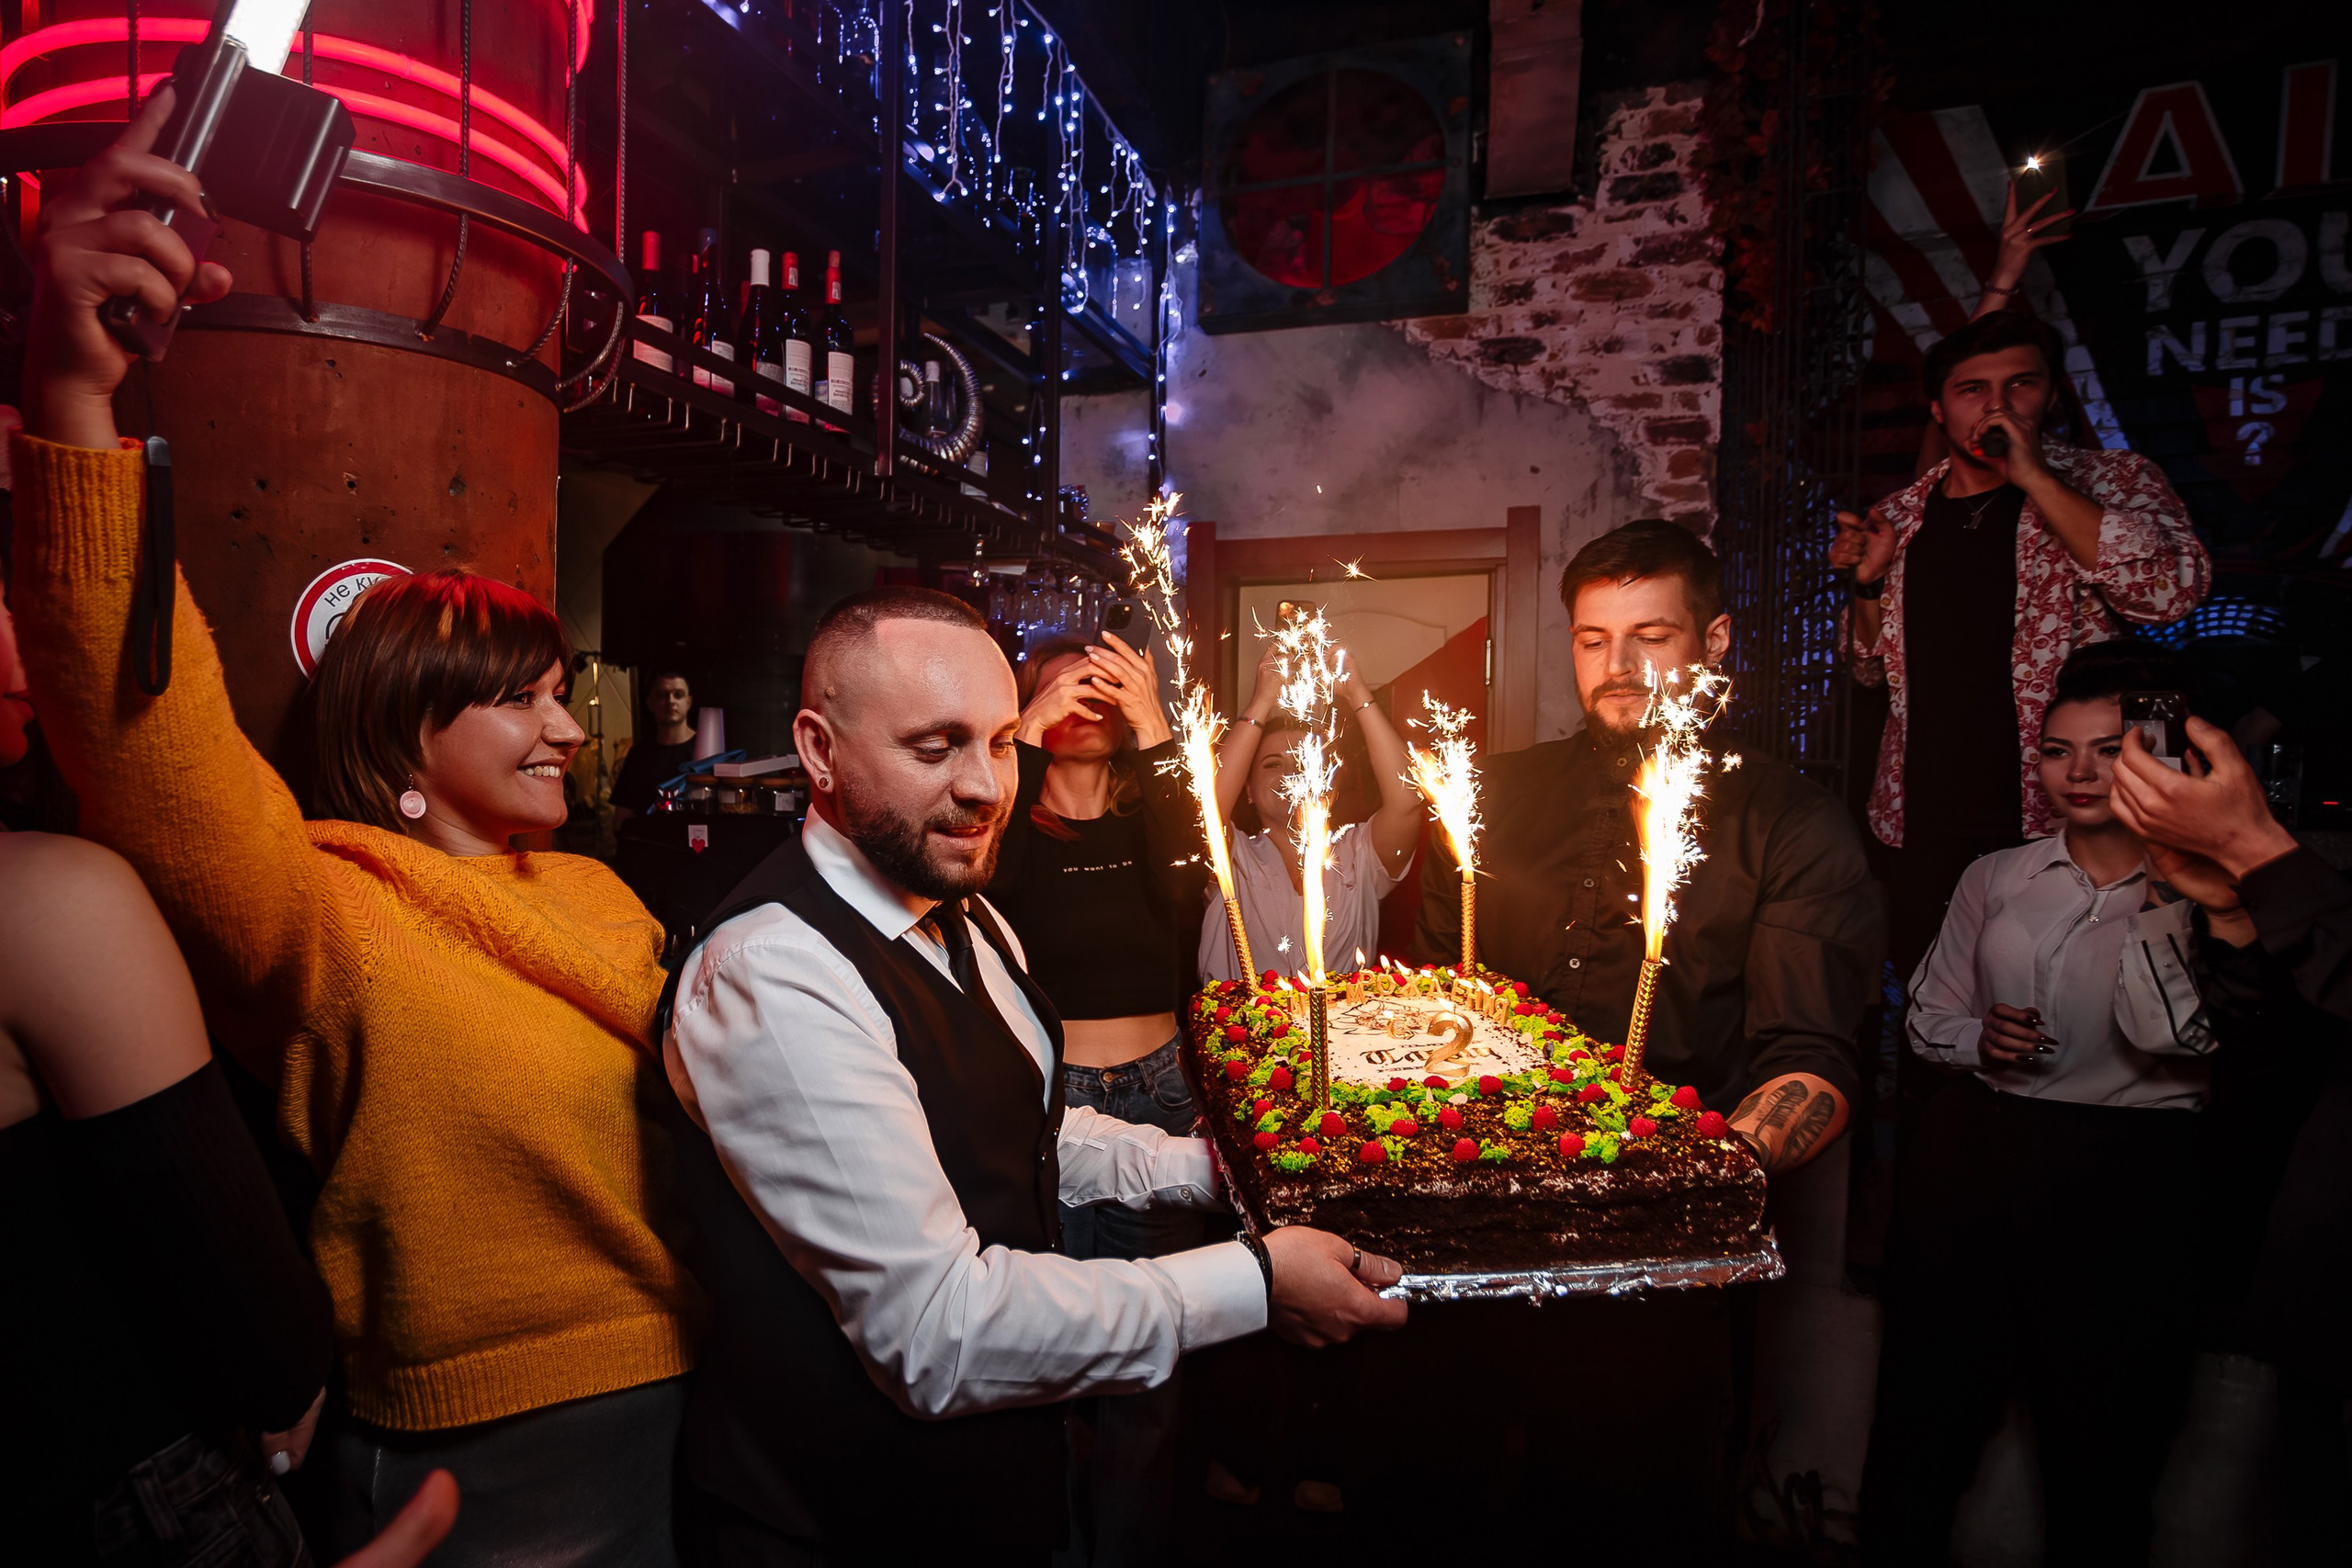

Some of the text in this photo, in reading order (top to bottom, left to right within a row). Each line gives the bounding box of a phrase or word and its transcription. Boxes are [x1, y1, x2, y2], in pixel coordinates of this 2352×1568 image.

[2228, 374, 2289, 417] IS
[2234, 421, 2278, 467] ?
[1425, 1010, 1474, 1077] 2
